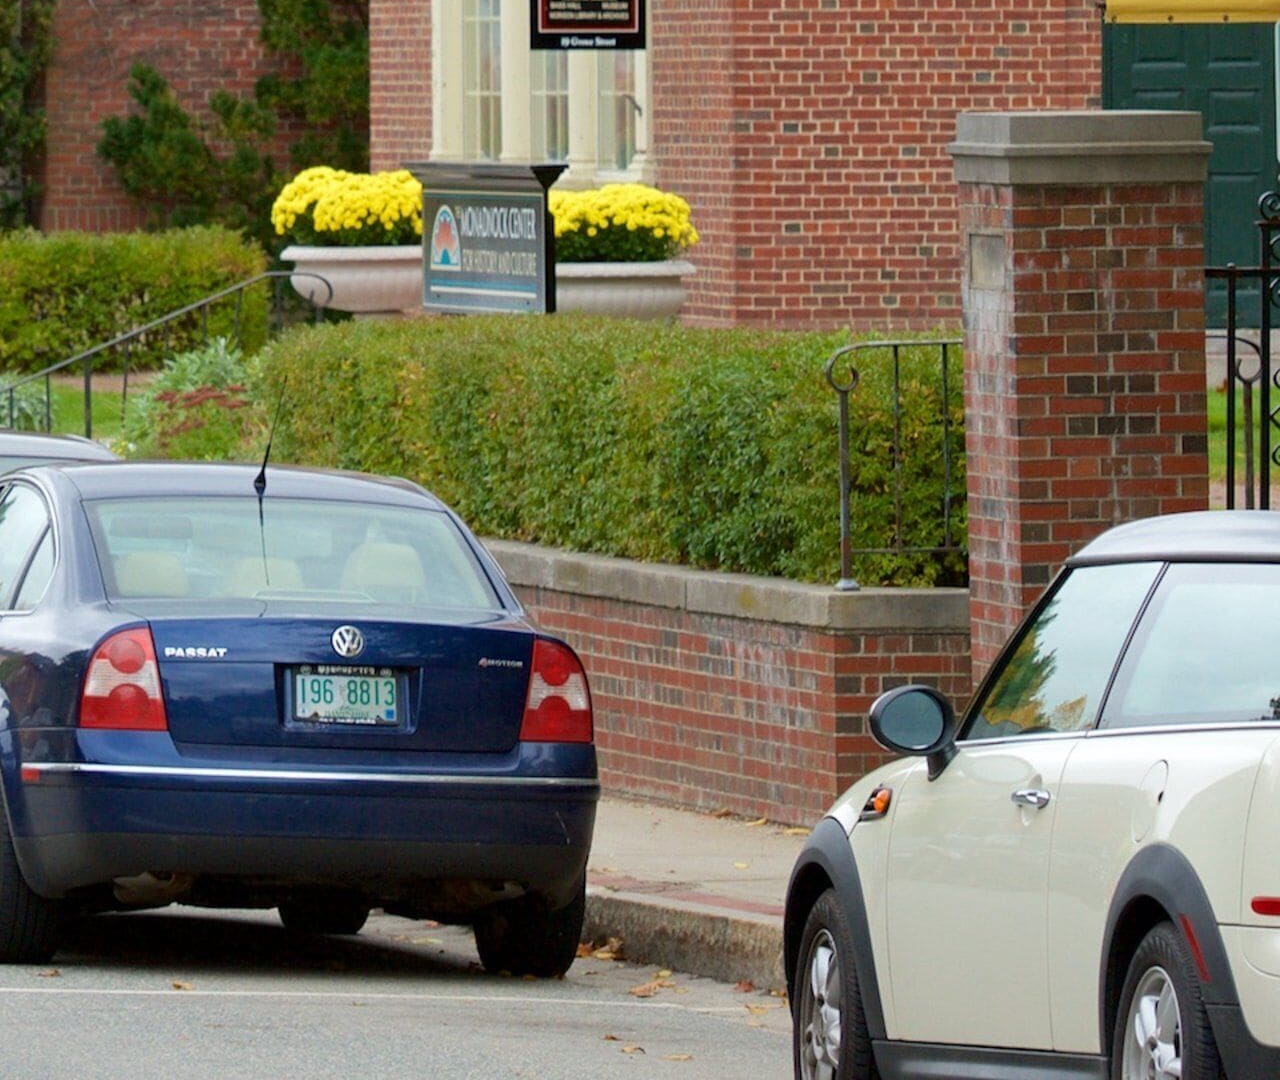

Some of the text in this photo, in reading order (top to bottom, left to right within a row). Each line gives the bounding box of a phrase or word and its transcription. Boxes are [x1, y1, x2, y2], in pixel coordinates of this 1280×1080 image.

[461, 206, 537, 241] MONADNOCK CENTER
[164, 647, 227, 658] PASSAT
[301, 677, 395, 706] 196 8813
